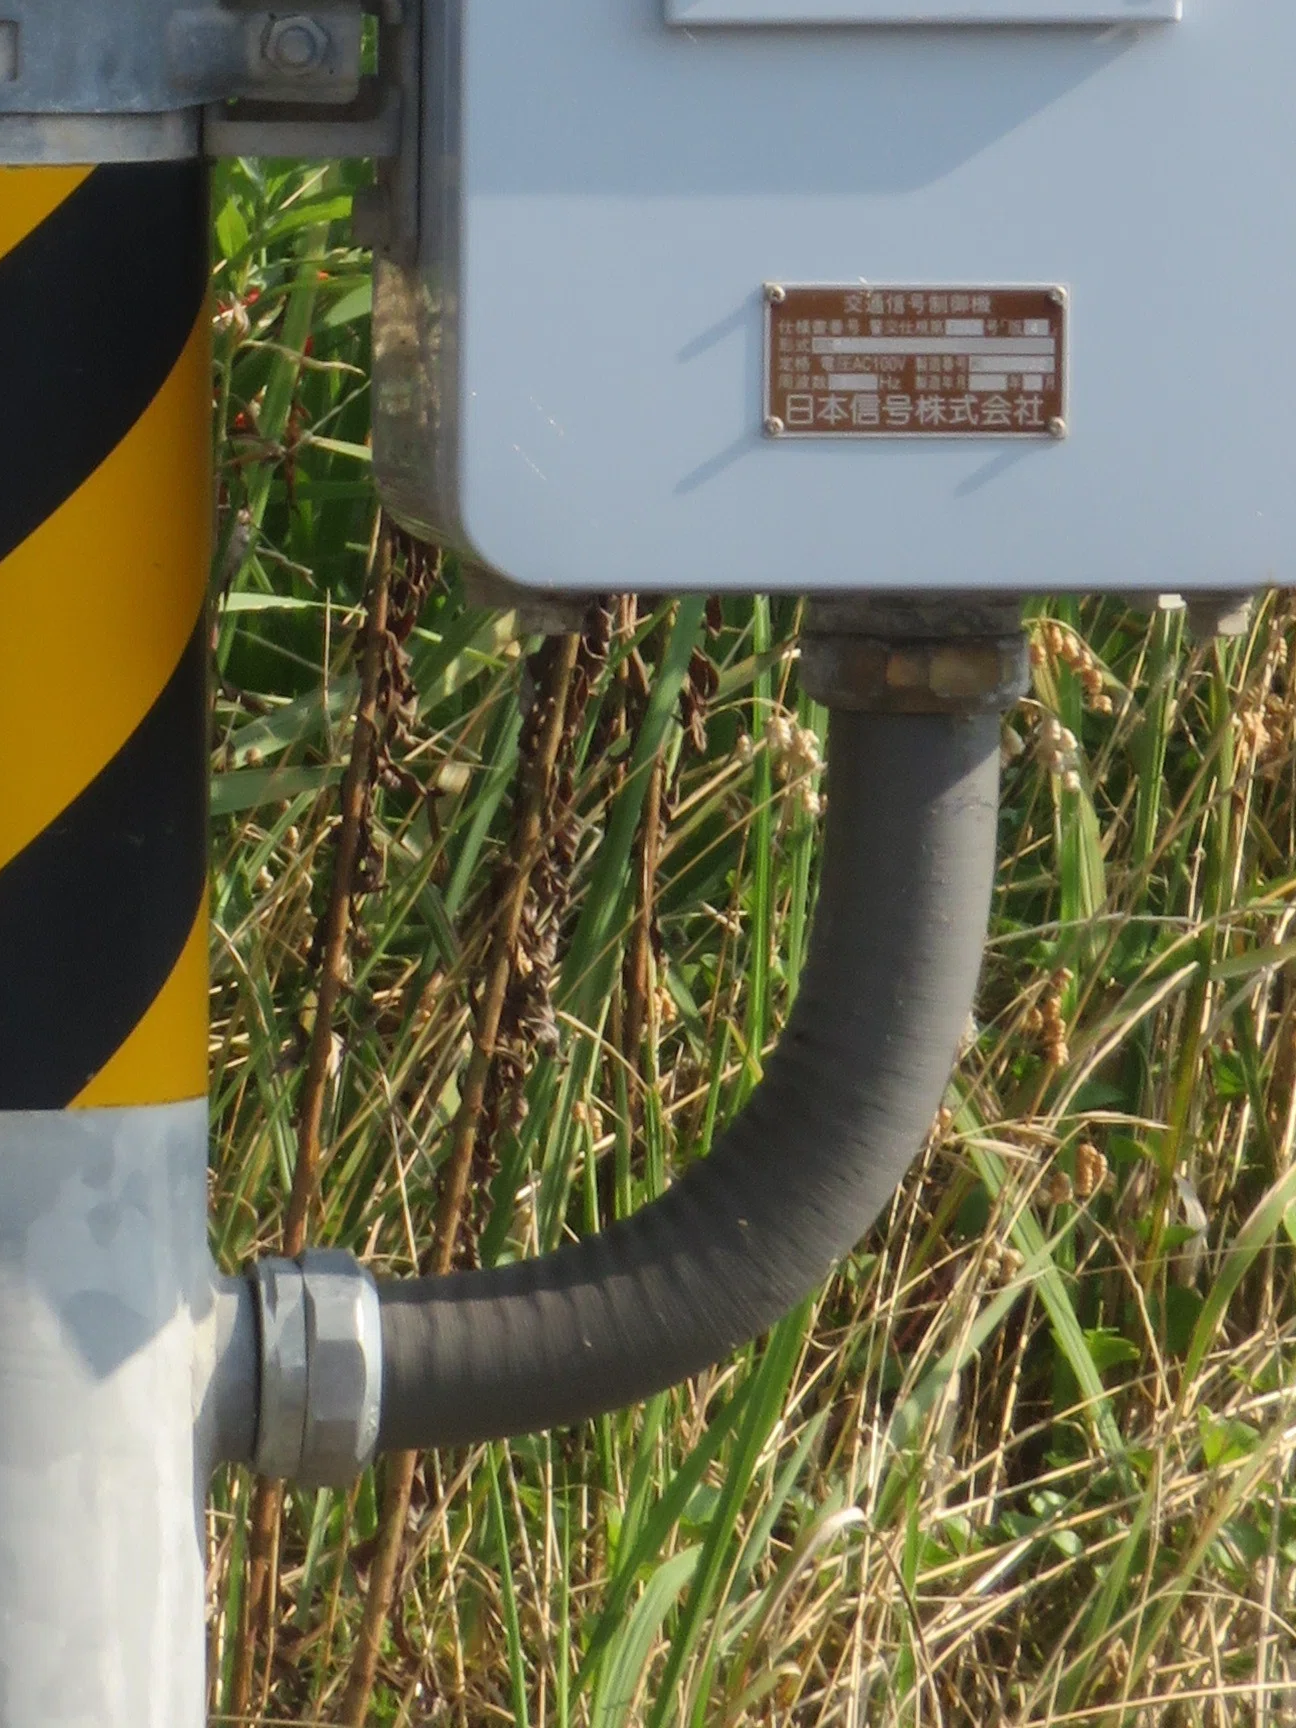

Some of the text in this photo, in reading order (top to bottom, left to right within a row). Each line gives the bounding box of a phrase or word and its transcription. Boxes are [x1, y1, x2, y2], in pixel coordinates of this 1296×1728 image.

[785, 394, 1044, 426] 日本信号株式会社
